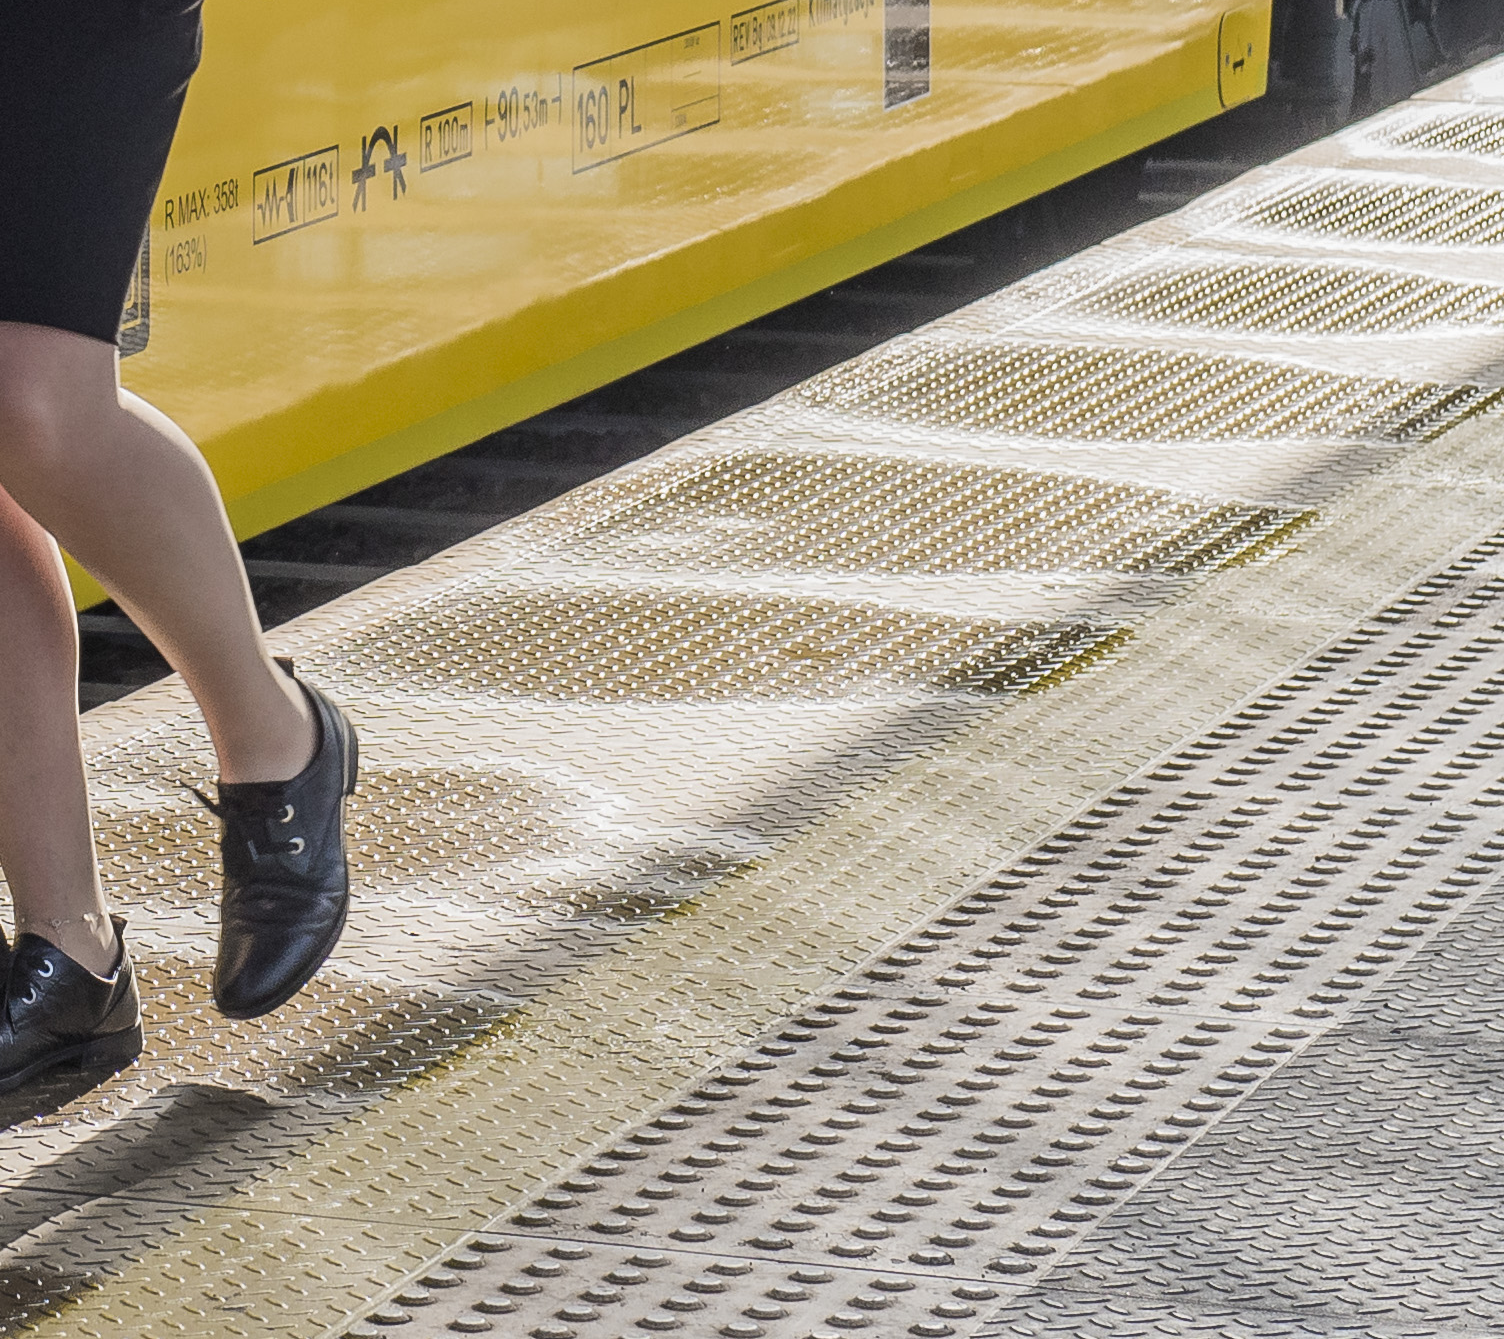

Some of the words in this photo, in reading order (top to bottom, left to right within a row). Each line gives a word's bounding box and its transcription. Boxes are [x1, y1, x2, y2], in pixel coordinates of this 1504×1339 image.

[733, 21, 750, 54] REV
[425, 124, 433, 165] R
[438, 116, 468, 159] 100m
[497, 86, 548, 143] 90,53m
[577, 86, 610, 153] 160
[619, 75, 642, 140] PL
[165, 199, 175, 231] R
[178, 188, 210, 227] MAX:
[213, 178, 240, 215] 358t
[306, 160, 335, 213] 116t
[165, 234, 207, 287] (163%)
